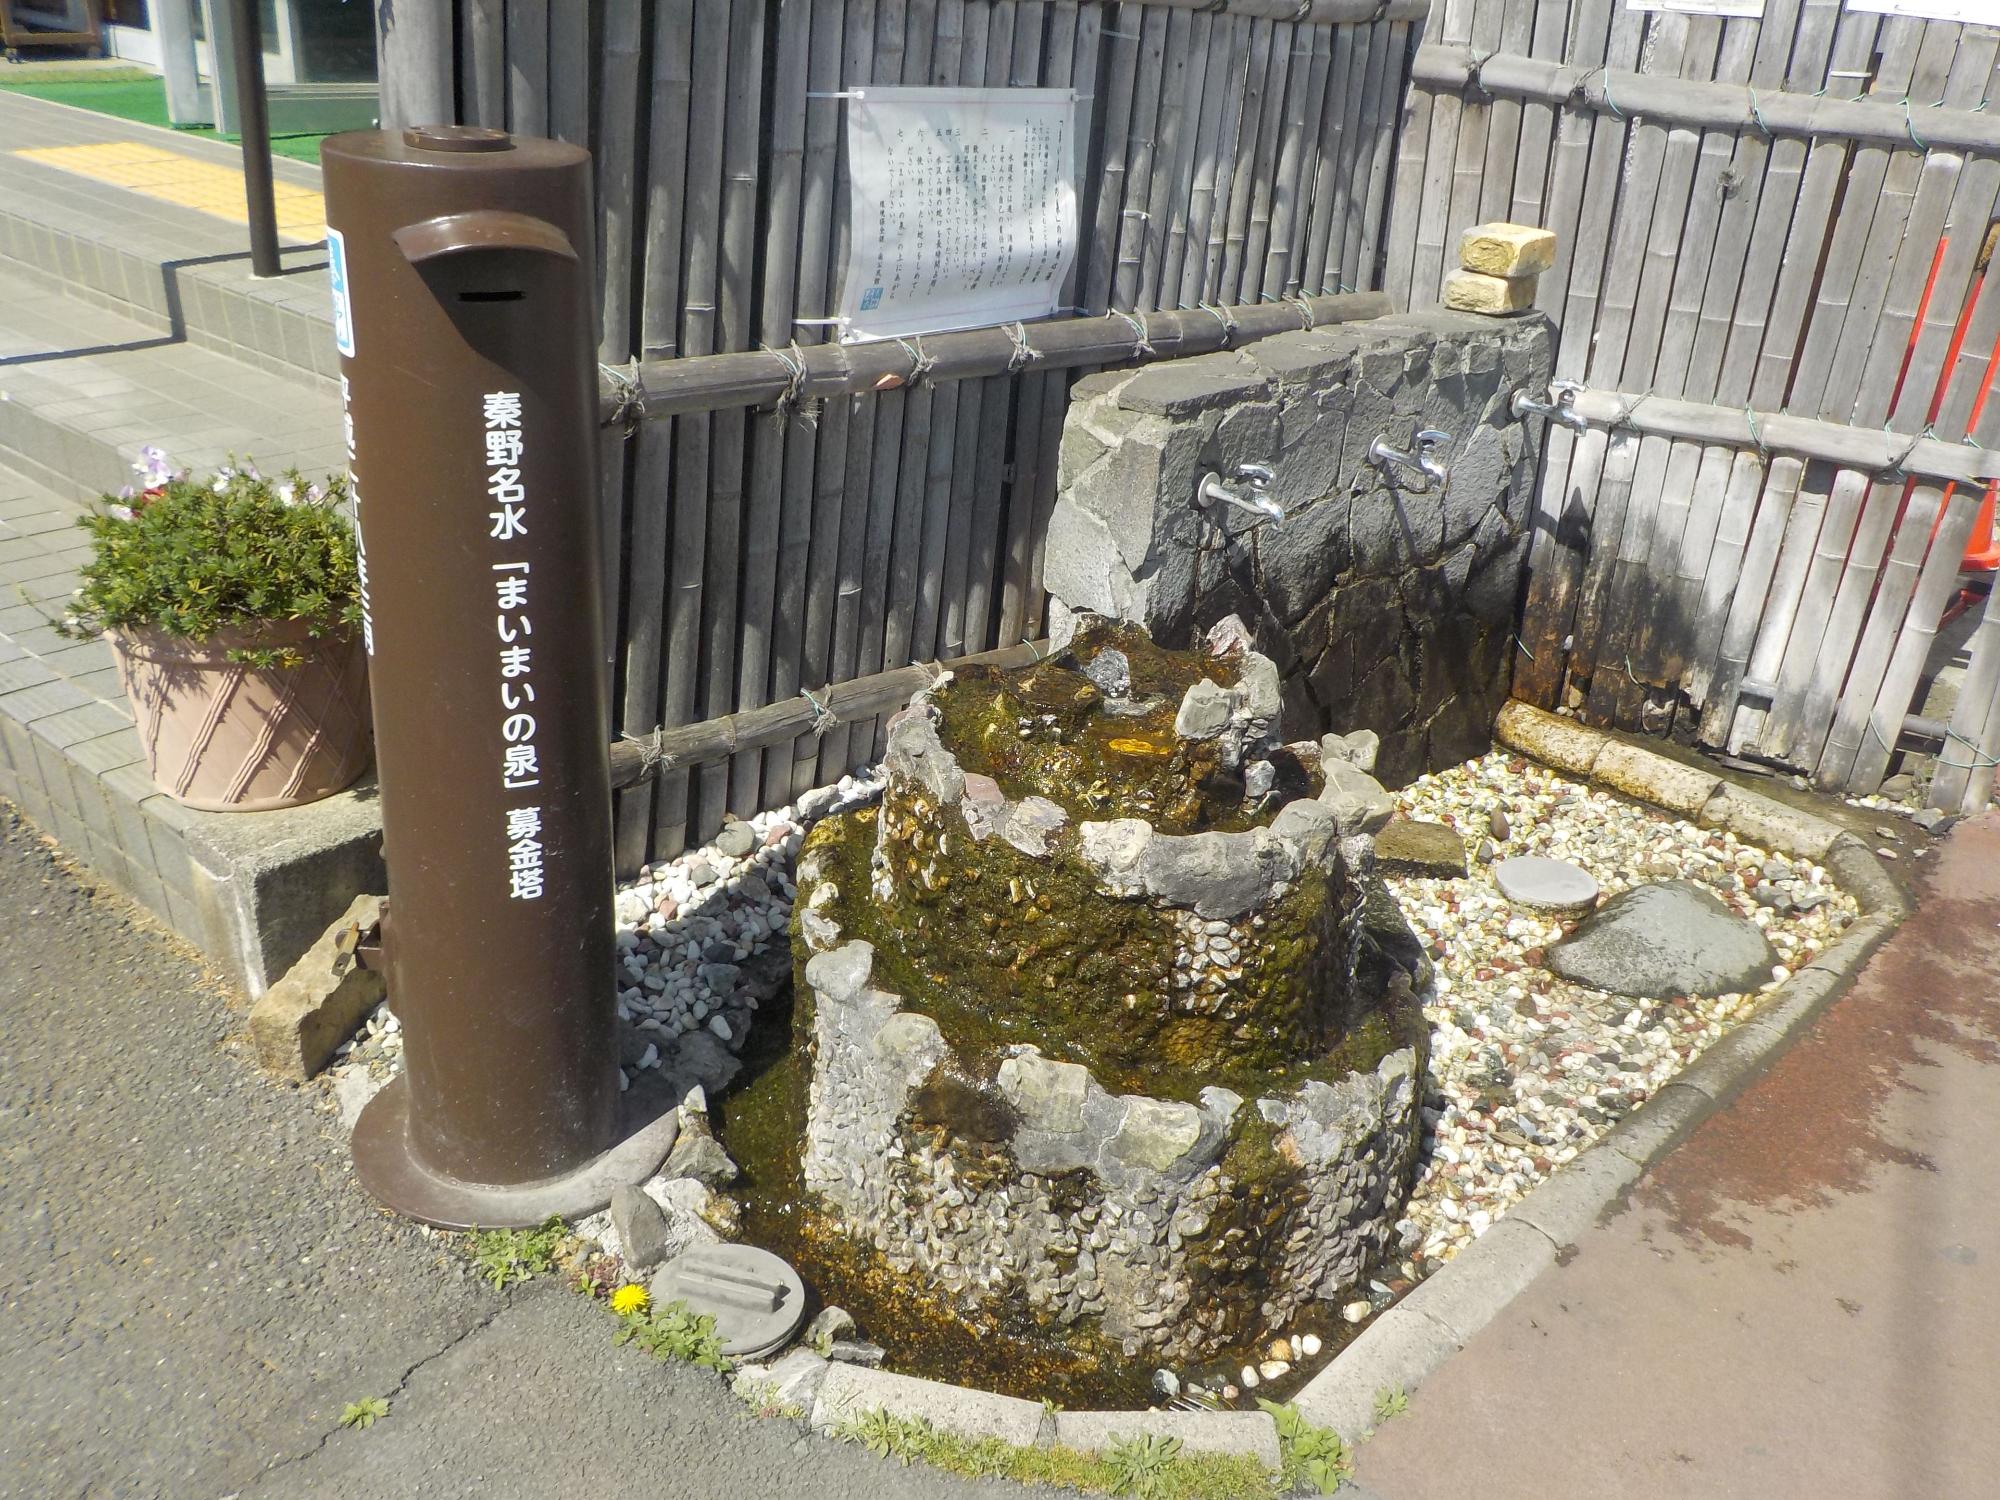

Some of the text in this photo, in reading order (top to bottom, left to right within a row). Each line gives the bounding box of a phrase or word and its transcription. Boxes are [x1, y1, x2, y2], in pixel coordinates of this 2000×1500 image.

[483, 391, 544, 899] 秦野名水 「まいまいの泉」 募金塔
